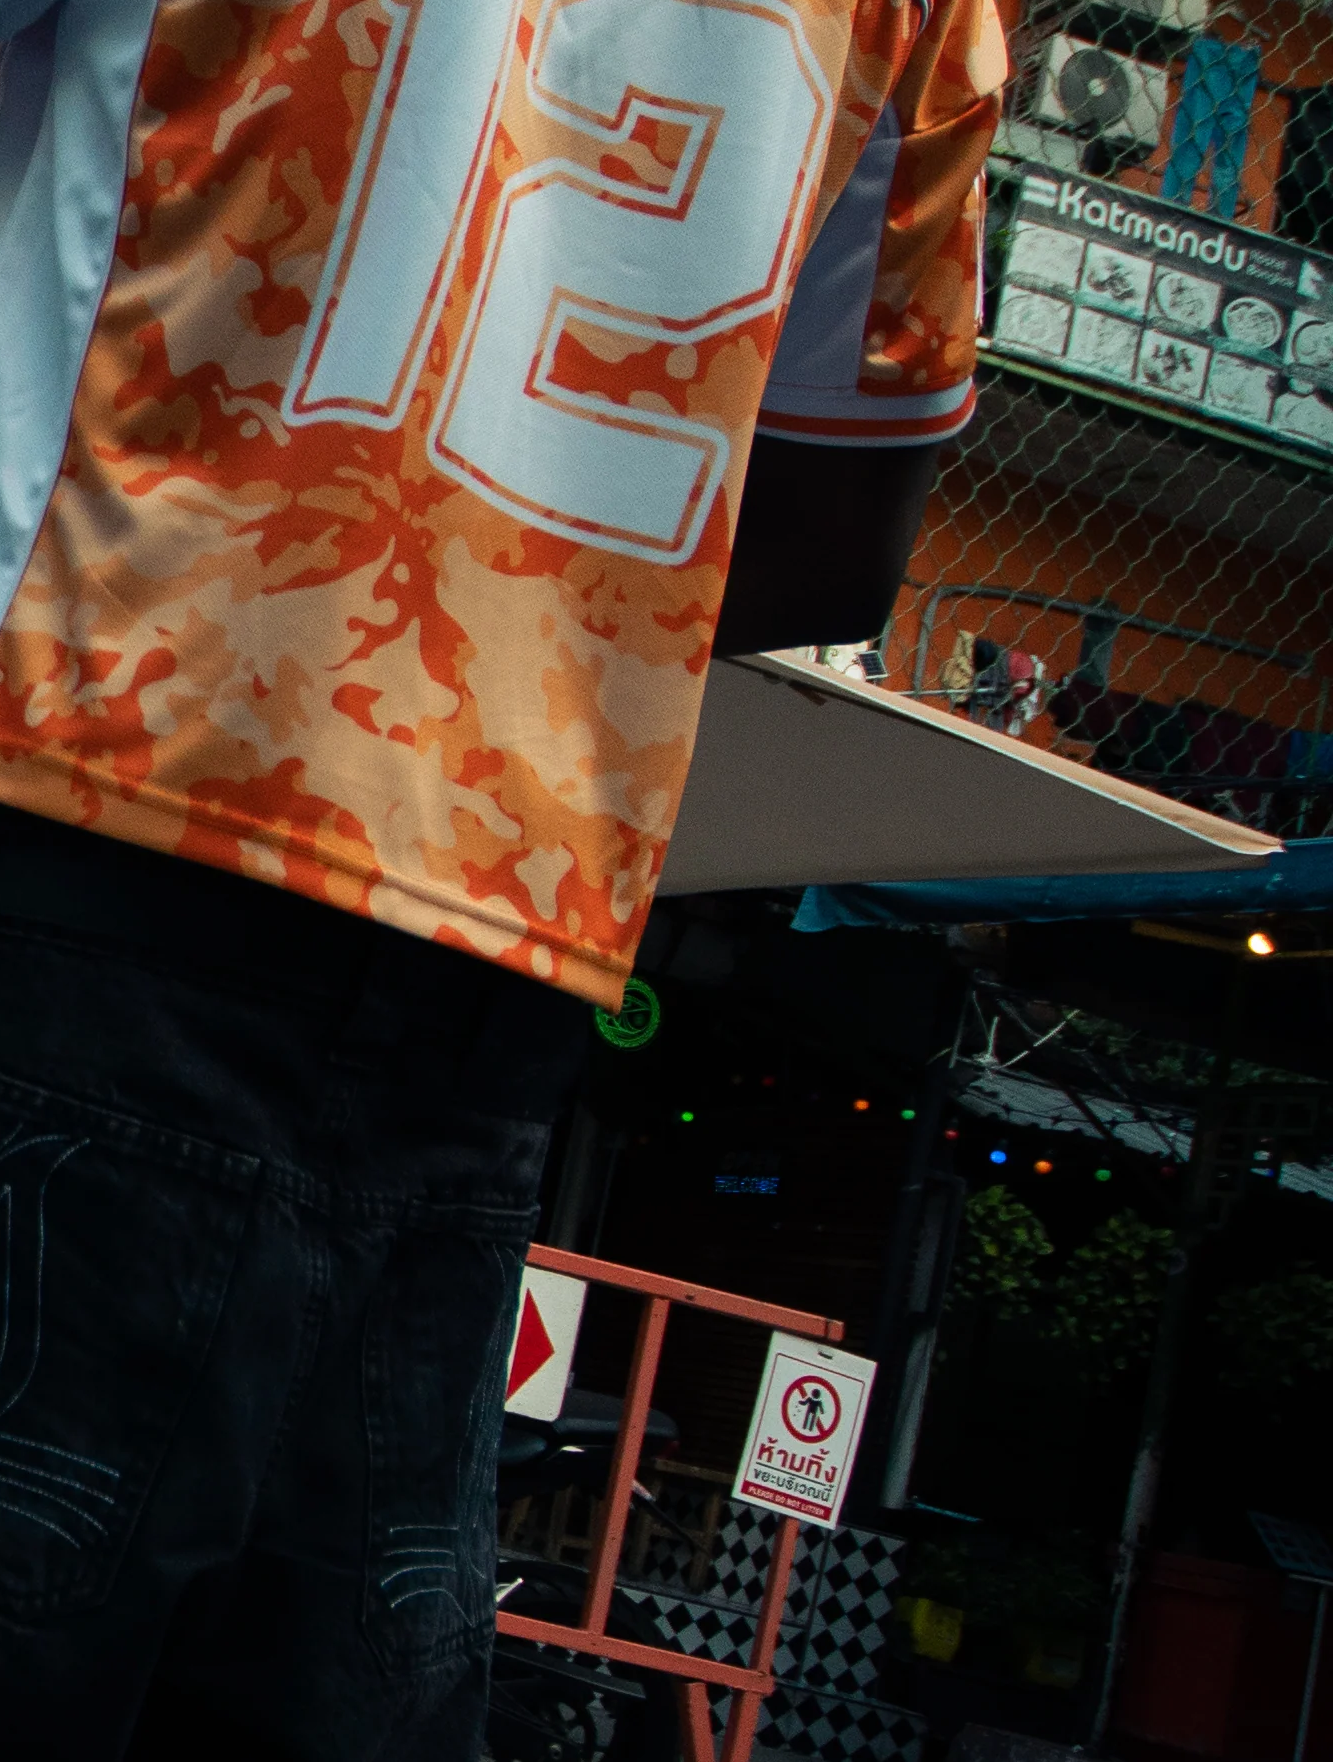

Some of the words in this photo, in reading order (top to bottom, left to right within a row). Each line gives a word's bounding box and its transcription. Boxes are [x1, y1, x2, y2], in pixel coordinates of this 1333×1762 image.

[1057, 181, 1250, 272] Katmandu
[756, 1436, 838, 1483] ห้ามทิ้ง
[749, 1485, 776, 1501] PLEASE
[785, 1496, 801, 1508] NOT
[801, 1501, 825, 1517] LITTER
[753, 1468, 837, 1502] ขยะบริเวณนี้
